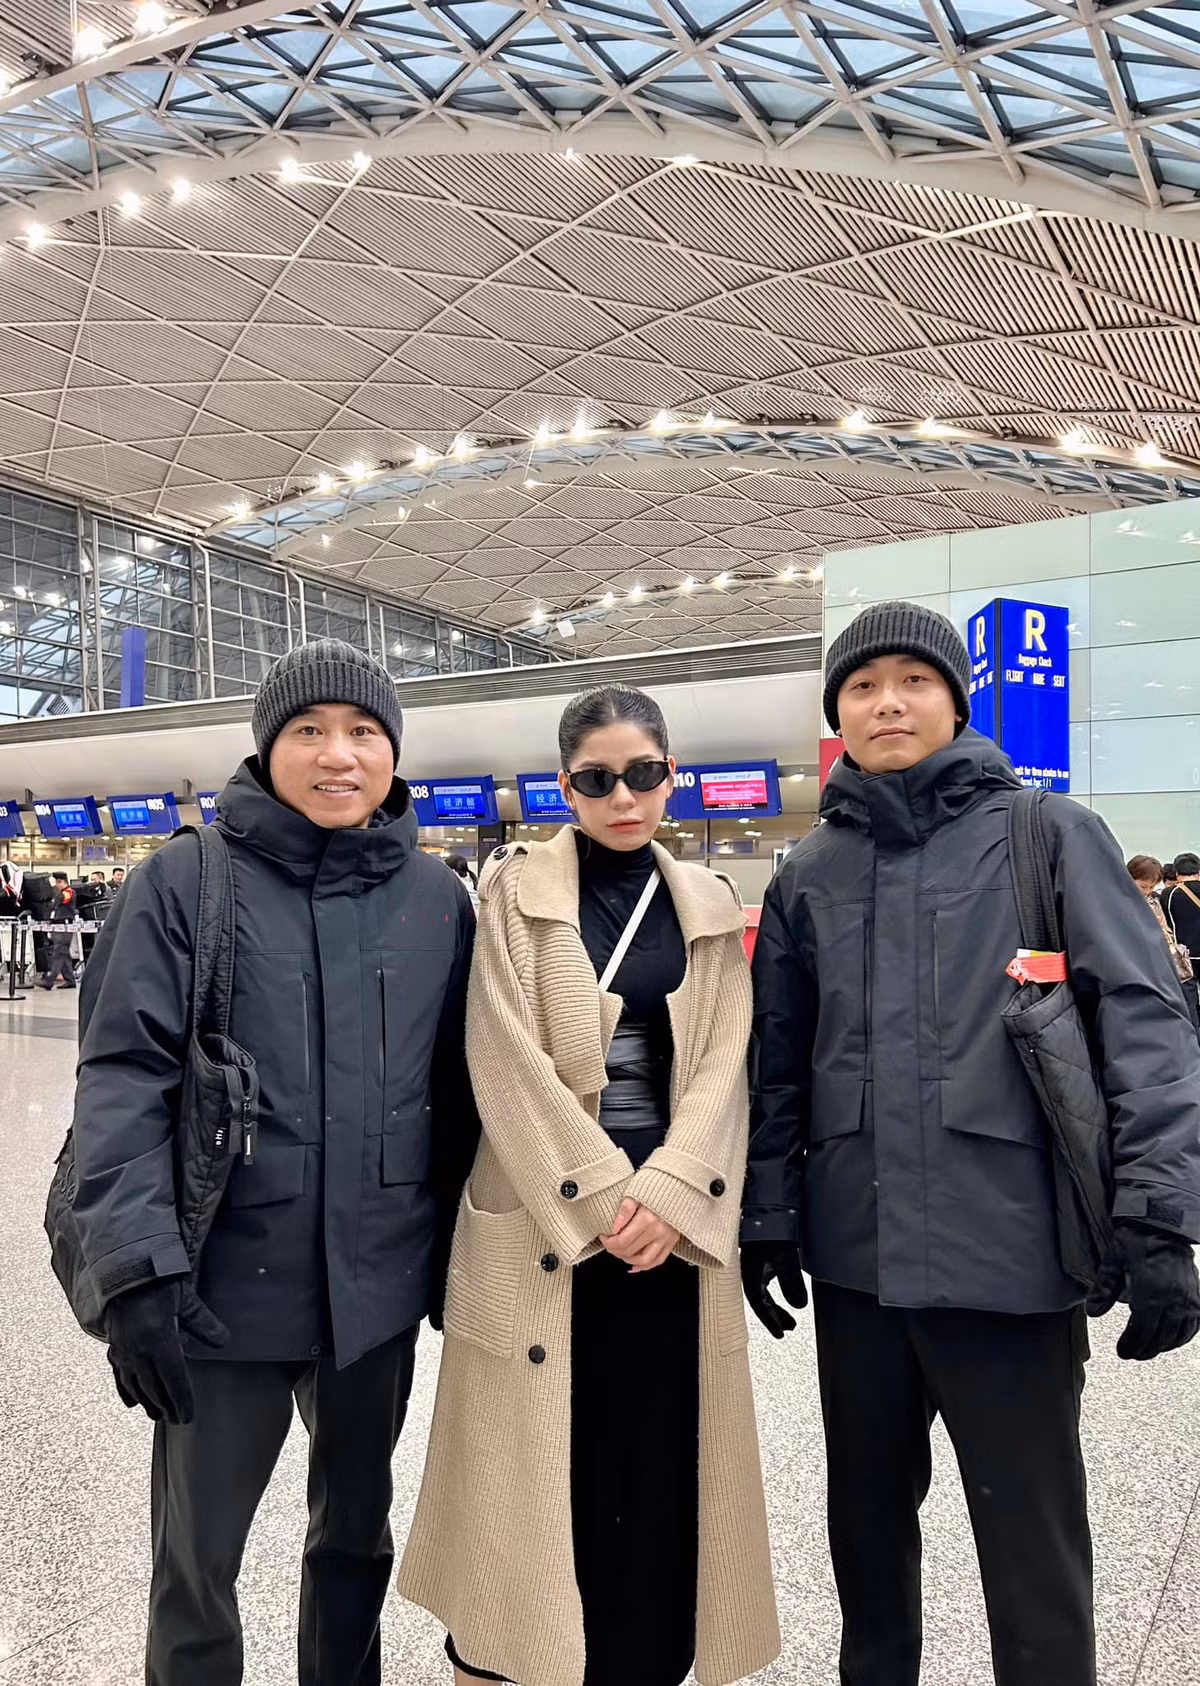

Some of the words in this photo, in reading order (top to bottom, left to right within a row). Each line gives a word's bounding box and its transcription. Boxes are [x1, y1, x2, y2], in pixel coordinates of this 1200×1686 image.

[976, 616, 986, 657] R
[1025, 608, 1047, 652] R
[1038, 656, 1052, 667] Check
[1005, 669, 1024, 683] FLIGHT
